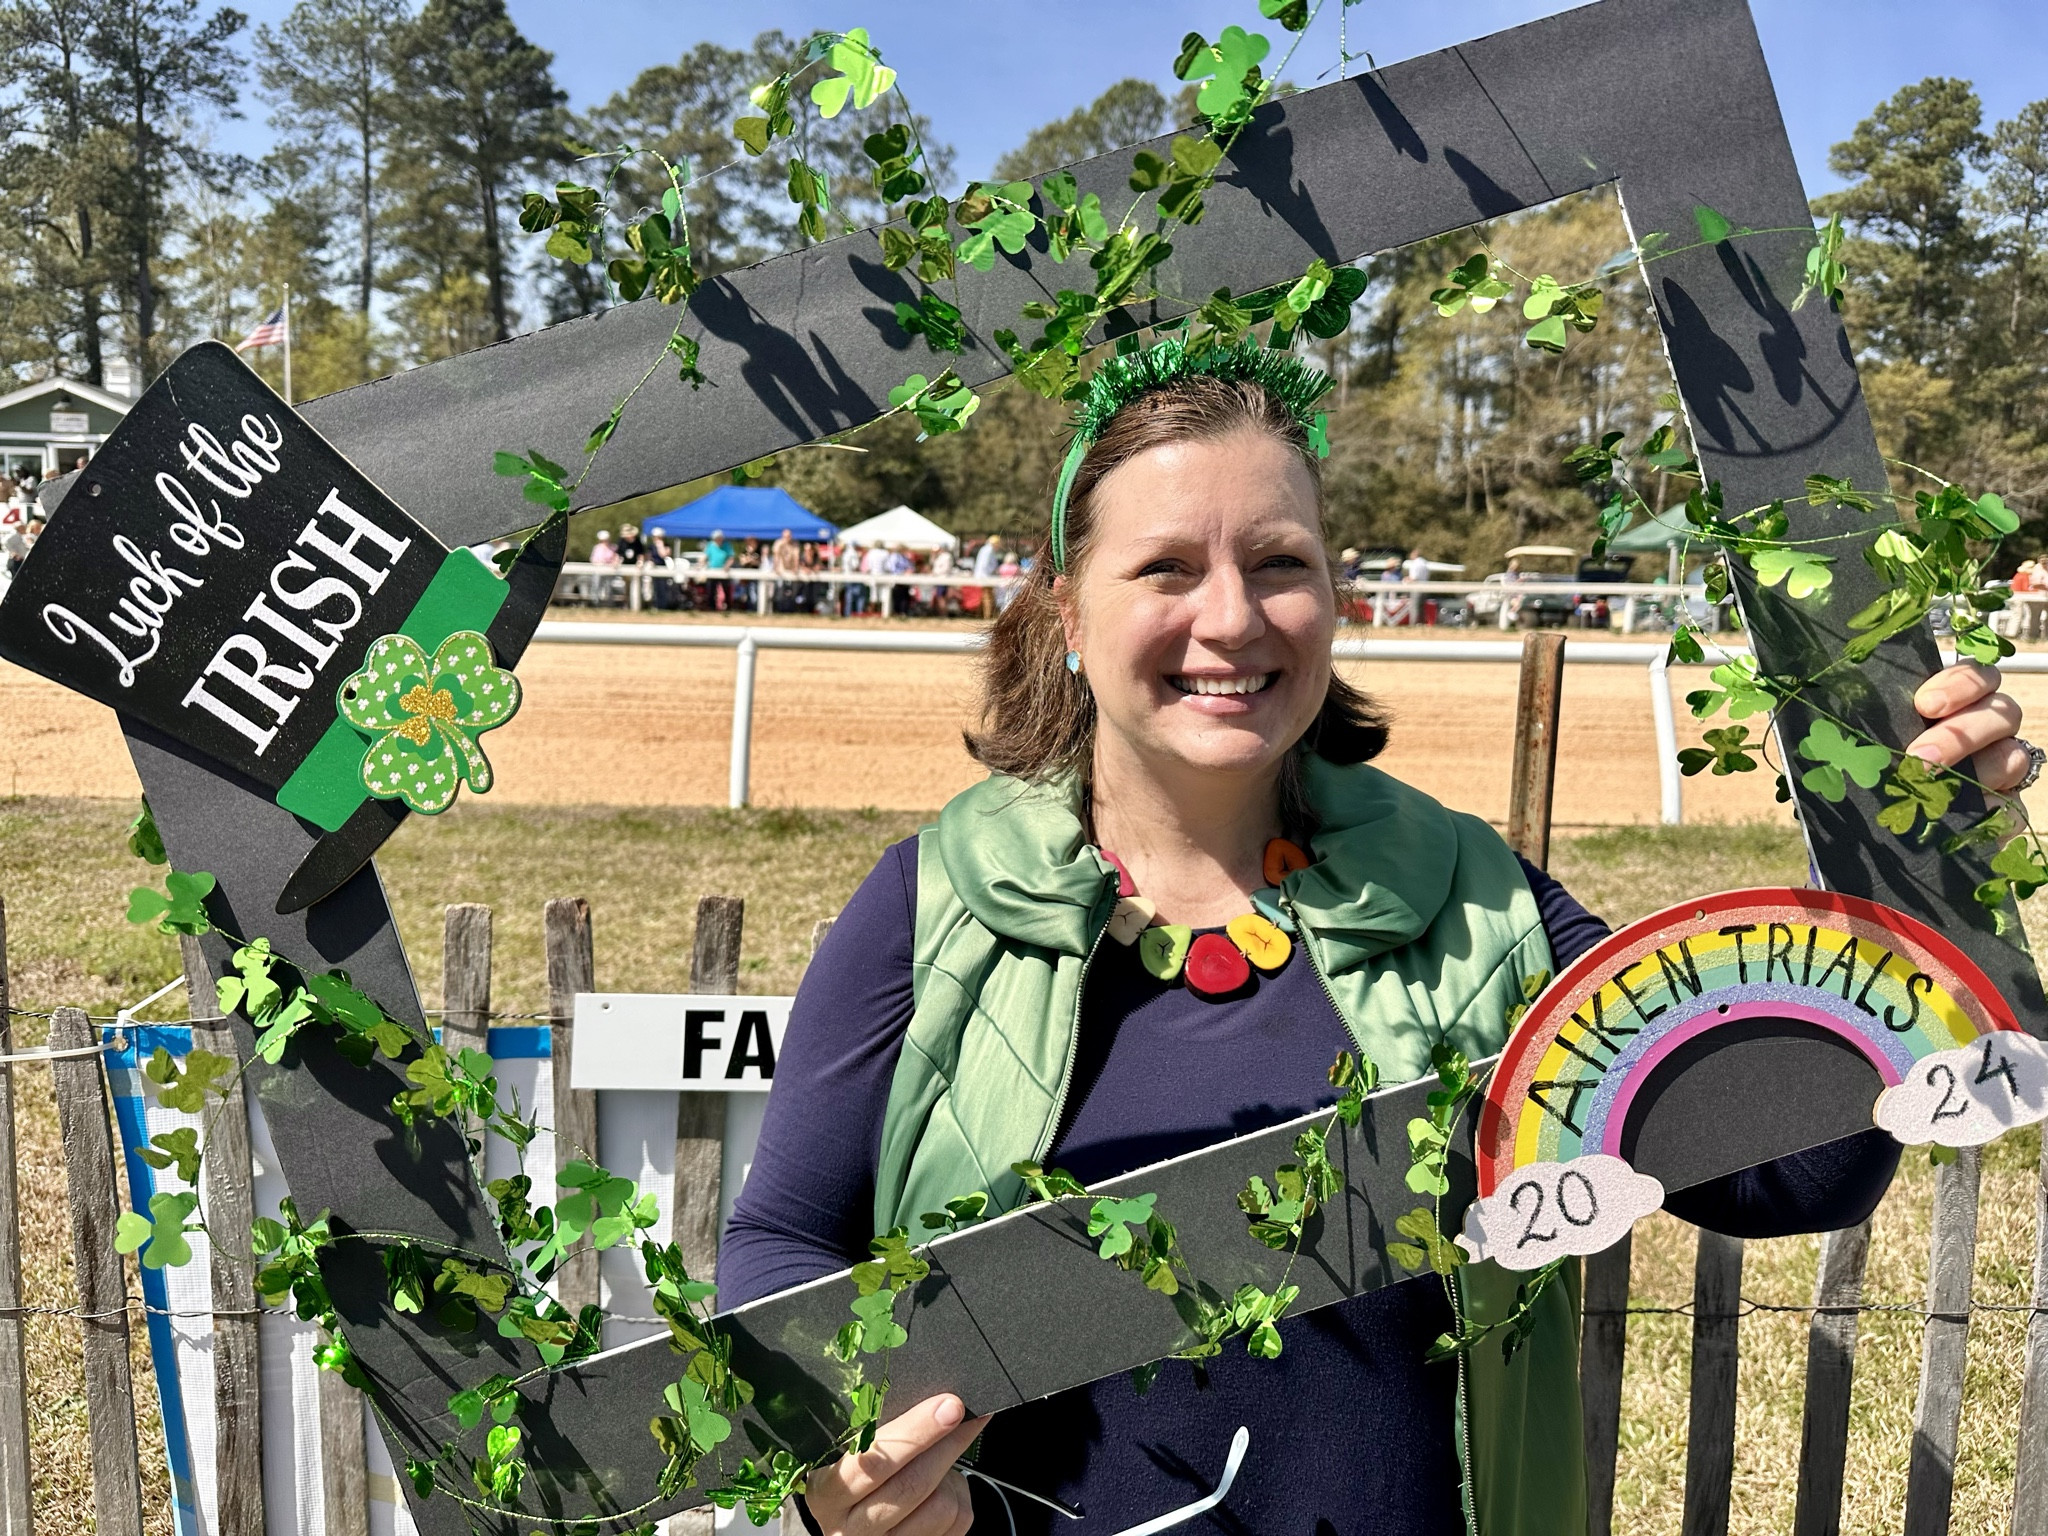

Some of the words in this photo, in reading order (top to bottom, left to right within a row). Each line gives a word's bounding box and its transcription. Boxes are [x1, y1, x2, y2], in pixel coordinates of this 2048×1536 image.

[178, 412, 283, 499] the
[155, 472, 245, 556] of
[42, 534, 205, 688] Luck
[181, 486, 412, 757] IRISH
[682, 1009, 793, 1080] FA
[1526, 936, 1703, 1139] AIKEN
[1718, 922, 1935, 1034] TRIALS
[1926, 1039, 2019, 1125] 24
[1508, 1171, 1598, 1250] 20
